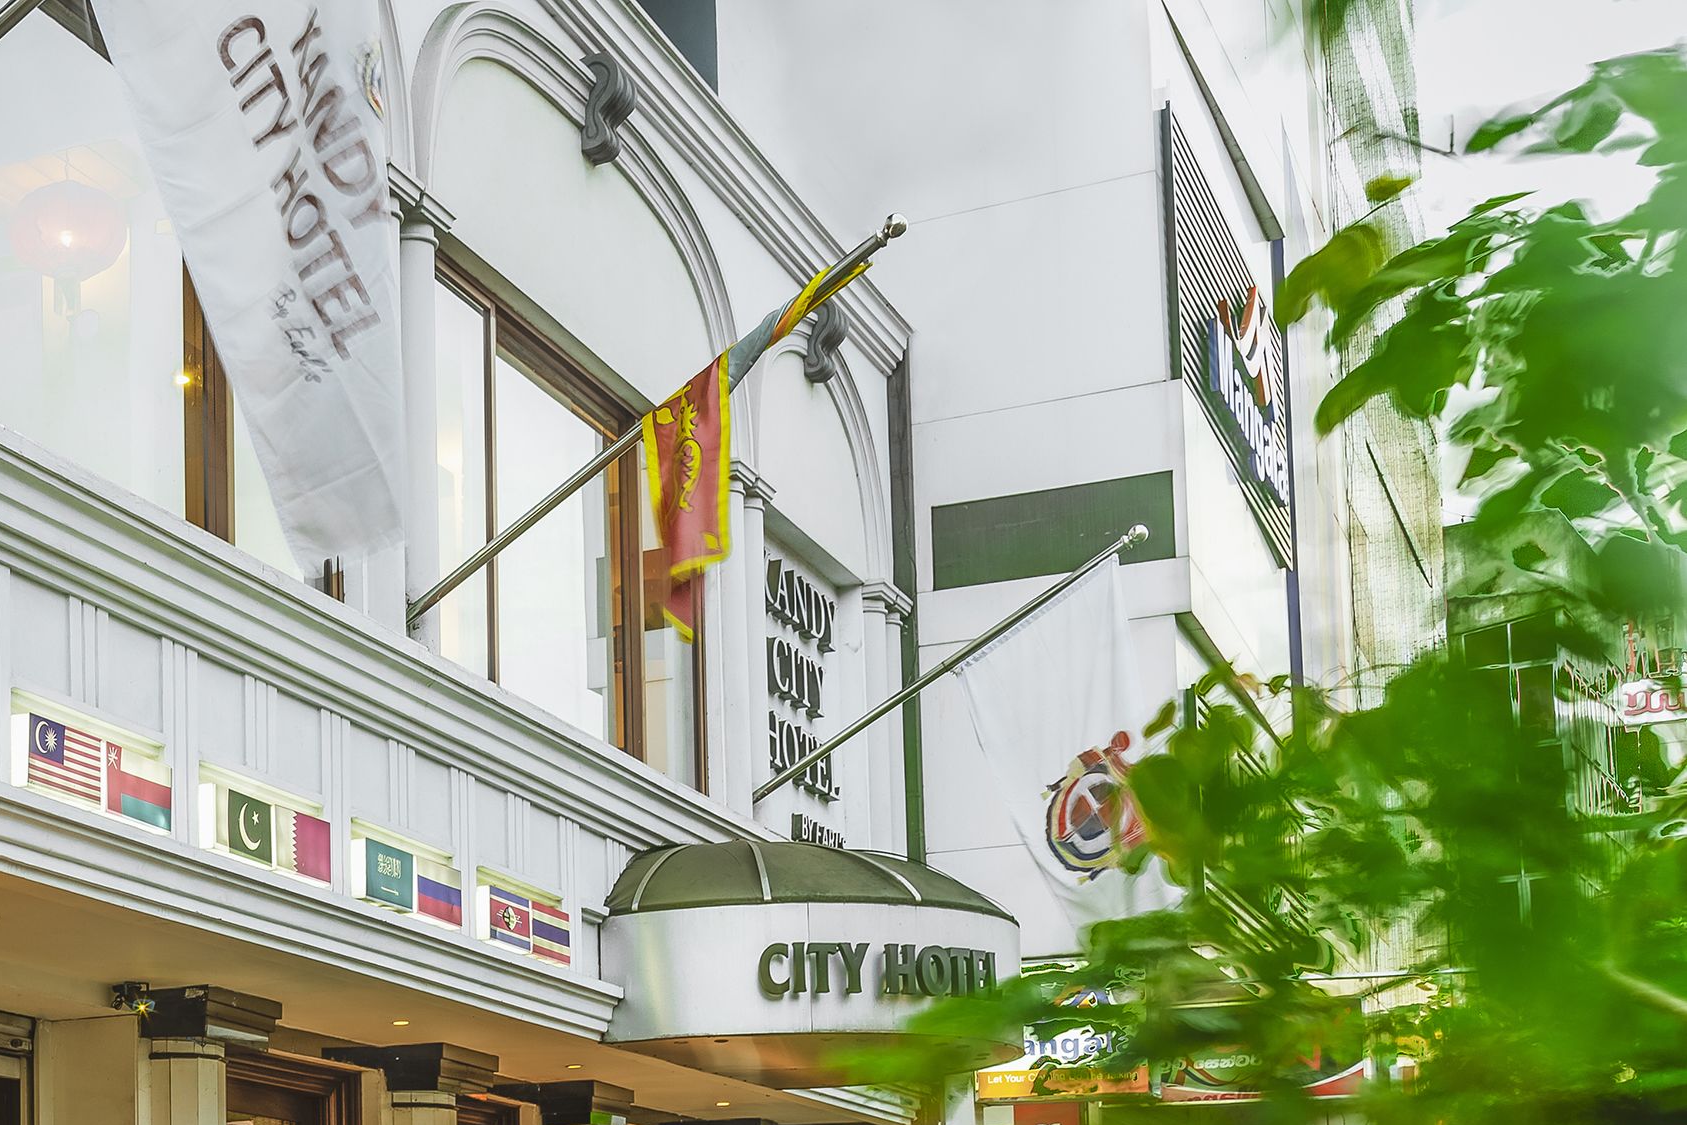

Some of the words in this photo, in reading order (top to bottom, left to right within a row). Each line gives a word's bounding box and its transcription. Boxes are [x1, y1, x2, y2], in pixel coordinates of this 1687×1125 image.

[216, 14, 299, 152] CITY
[270, 147, 382, 362] HOTEL
[771, 637, 826, 718] CITY
[769, 711, 841, 801] HOTEL
[801, 815, 815, 842] BY
[758, 942, 870, 995] CITY
[882, 943, 1000, 998] HOTEL
[1024, 1030, 1115, 1059] angal
[987, 1074, 1003, 1084] Let
[1004, 1073, 1026, 1084] Your
